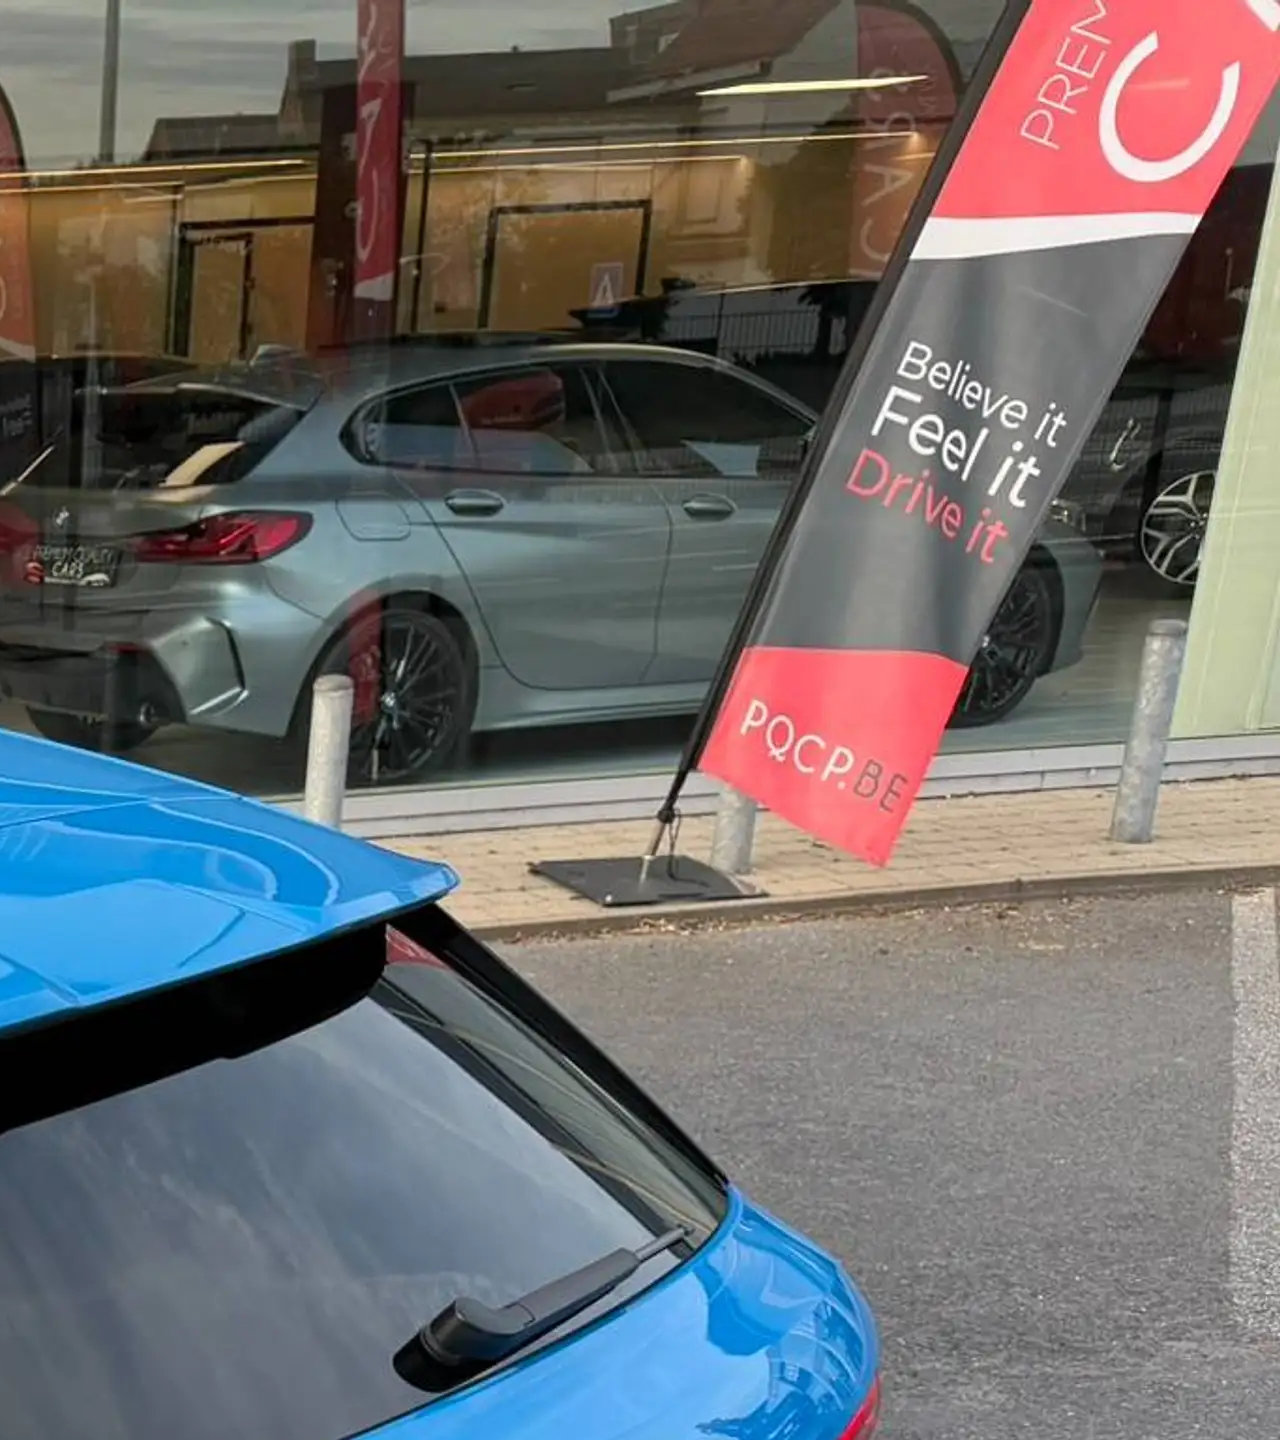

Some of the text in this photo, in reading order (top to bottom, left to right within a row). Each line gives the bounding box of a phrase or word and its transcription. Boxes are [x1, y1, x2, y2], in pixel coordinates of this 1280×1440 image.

[1020, 0, 1112, 151] PREM
[1098, 0, 1280, 183] C
[871, 385, 1041, 509] Feel it
[896, 340, 1068, 448] Believe it
[846, 448, 1009, 564] Drive it
[740, 698, 909, 813] PQCP.BE
